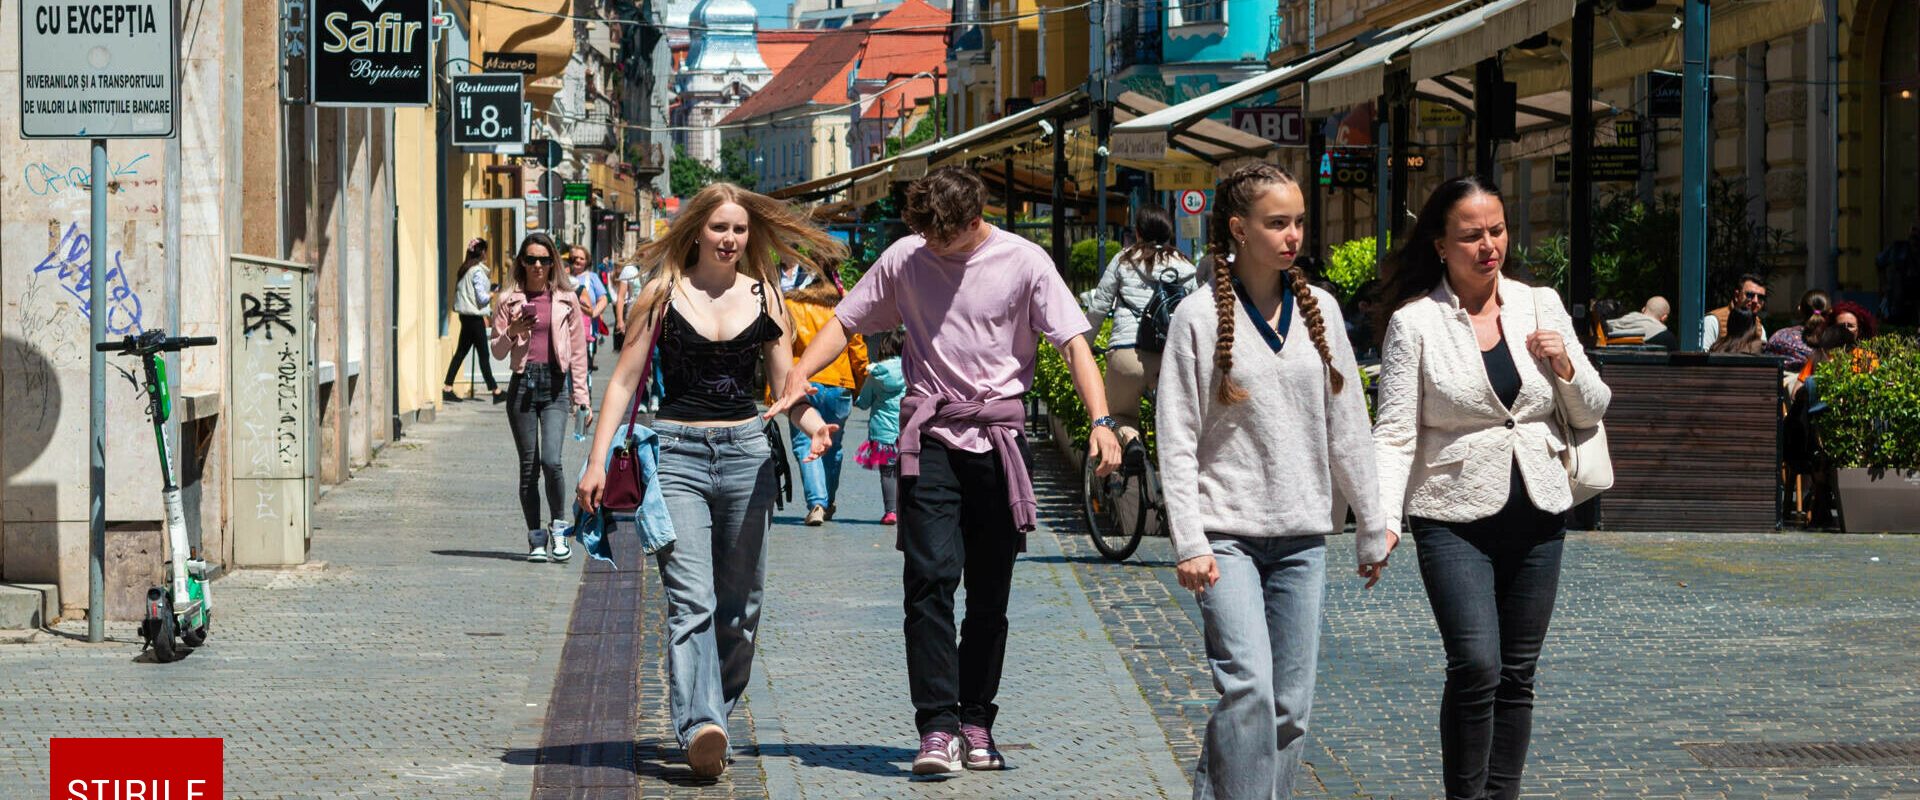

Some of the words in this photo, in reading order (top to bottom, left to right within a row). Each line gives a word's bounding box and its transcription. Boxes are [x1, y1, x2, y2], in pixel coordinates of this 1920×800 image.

[36, 5, 61, 35] CU
[67, 5, 156, 37] EXCEPȚIA
[323, 12, 422, 53] Safir
[26, 74, 78, 89] RIVERANILOR
[80, 74, 89, 91] ȘI
[90, 74, 97, 89] A
[99, 74, 164, 89] TRANSPORTULUI
[349, 58, 422, 85] Bijuterii
[456, 81, 519, 93] Restaurant
[24, 100, 35, 114] DE
[37, 100, 65, 114] VALORI
[67, 100, 77, 114] LA
[79, 100, 130, 116] INSTITUȚIILE
[133, 100, 170, 114] BANCARE
[466, 125, 480, 135] La
[1240, 113, 1299, 141] ABC
